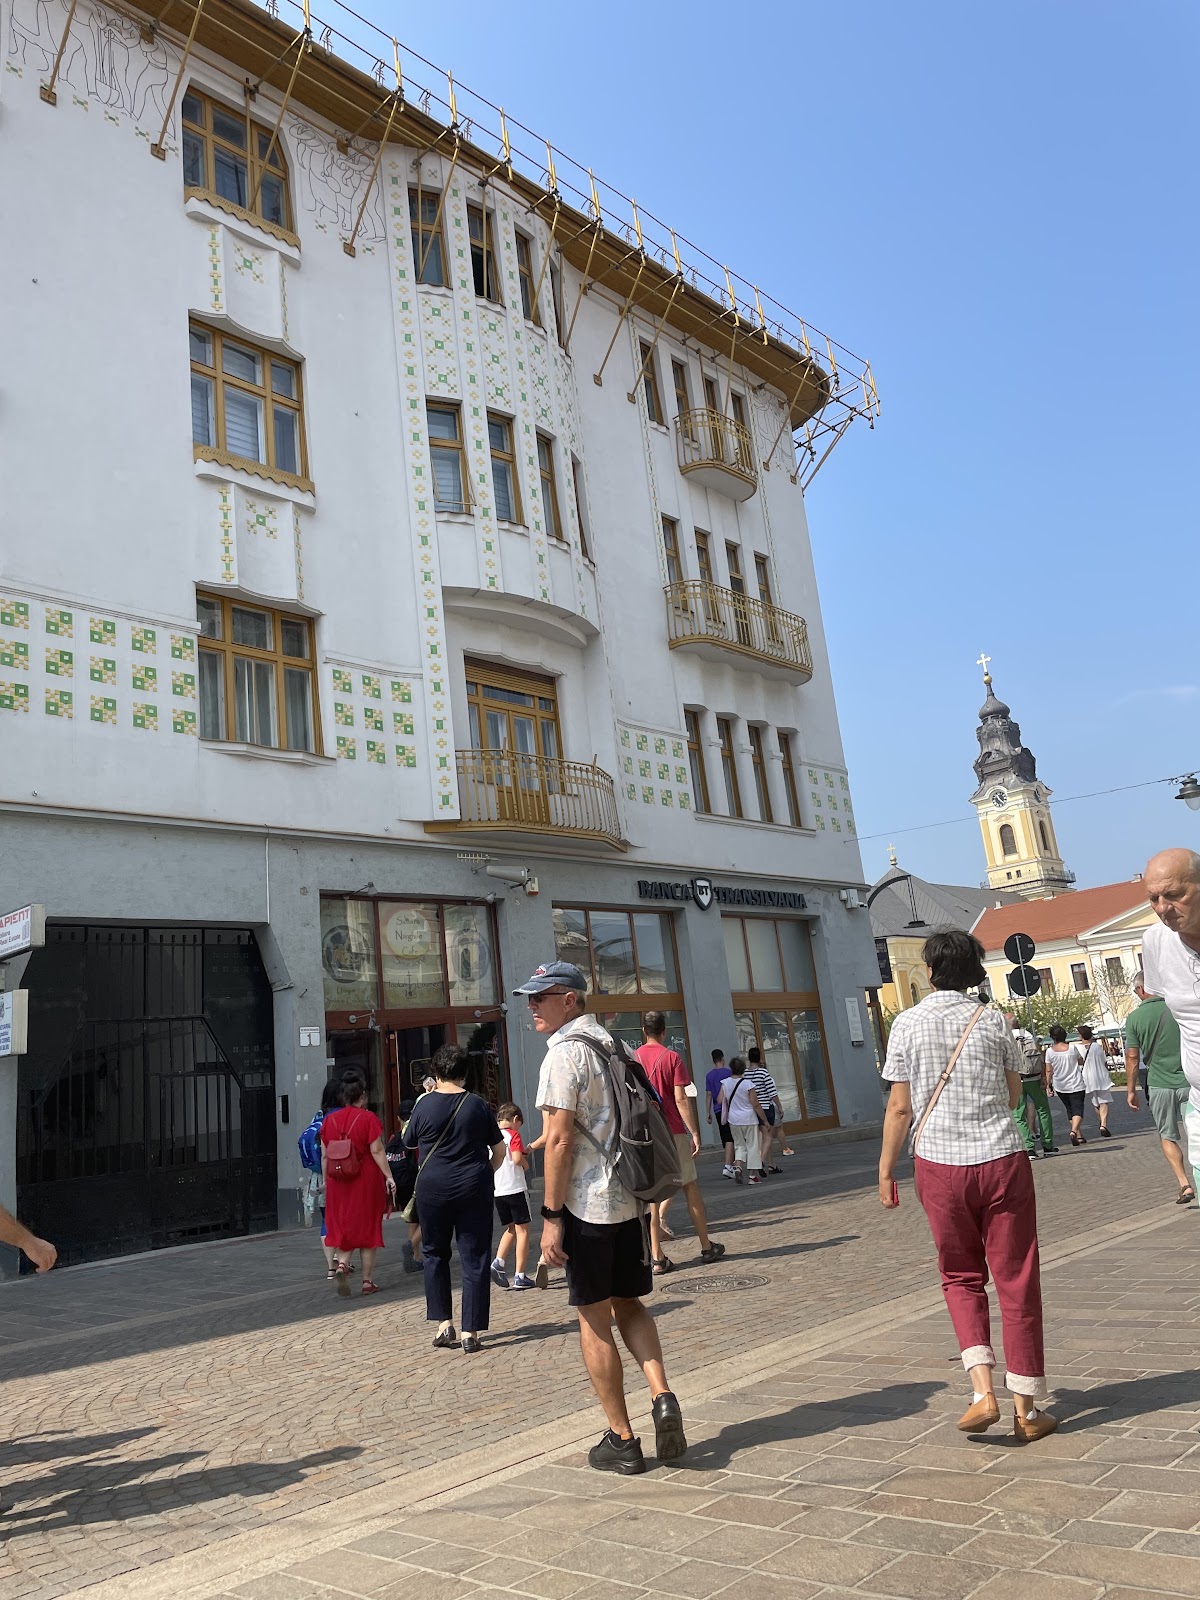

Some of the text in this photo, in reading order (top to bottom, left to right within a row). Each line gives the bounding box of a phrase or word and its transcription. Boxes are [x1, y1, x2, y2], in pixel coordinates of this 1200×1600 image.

[637, 880, 808, 909] BANCA BT TRANSILVANIA
[9, 934, 20, 942] Estate
[307, 1033, 313, 1045] 1
